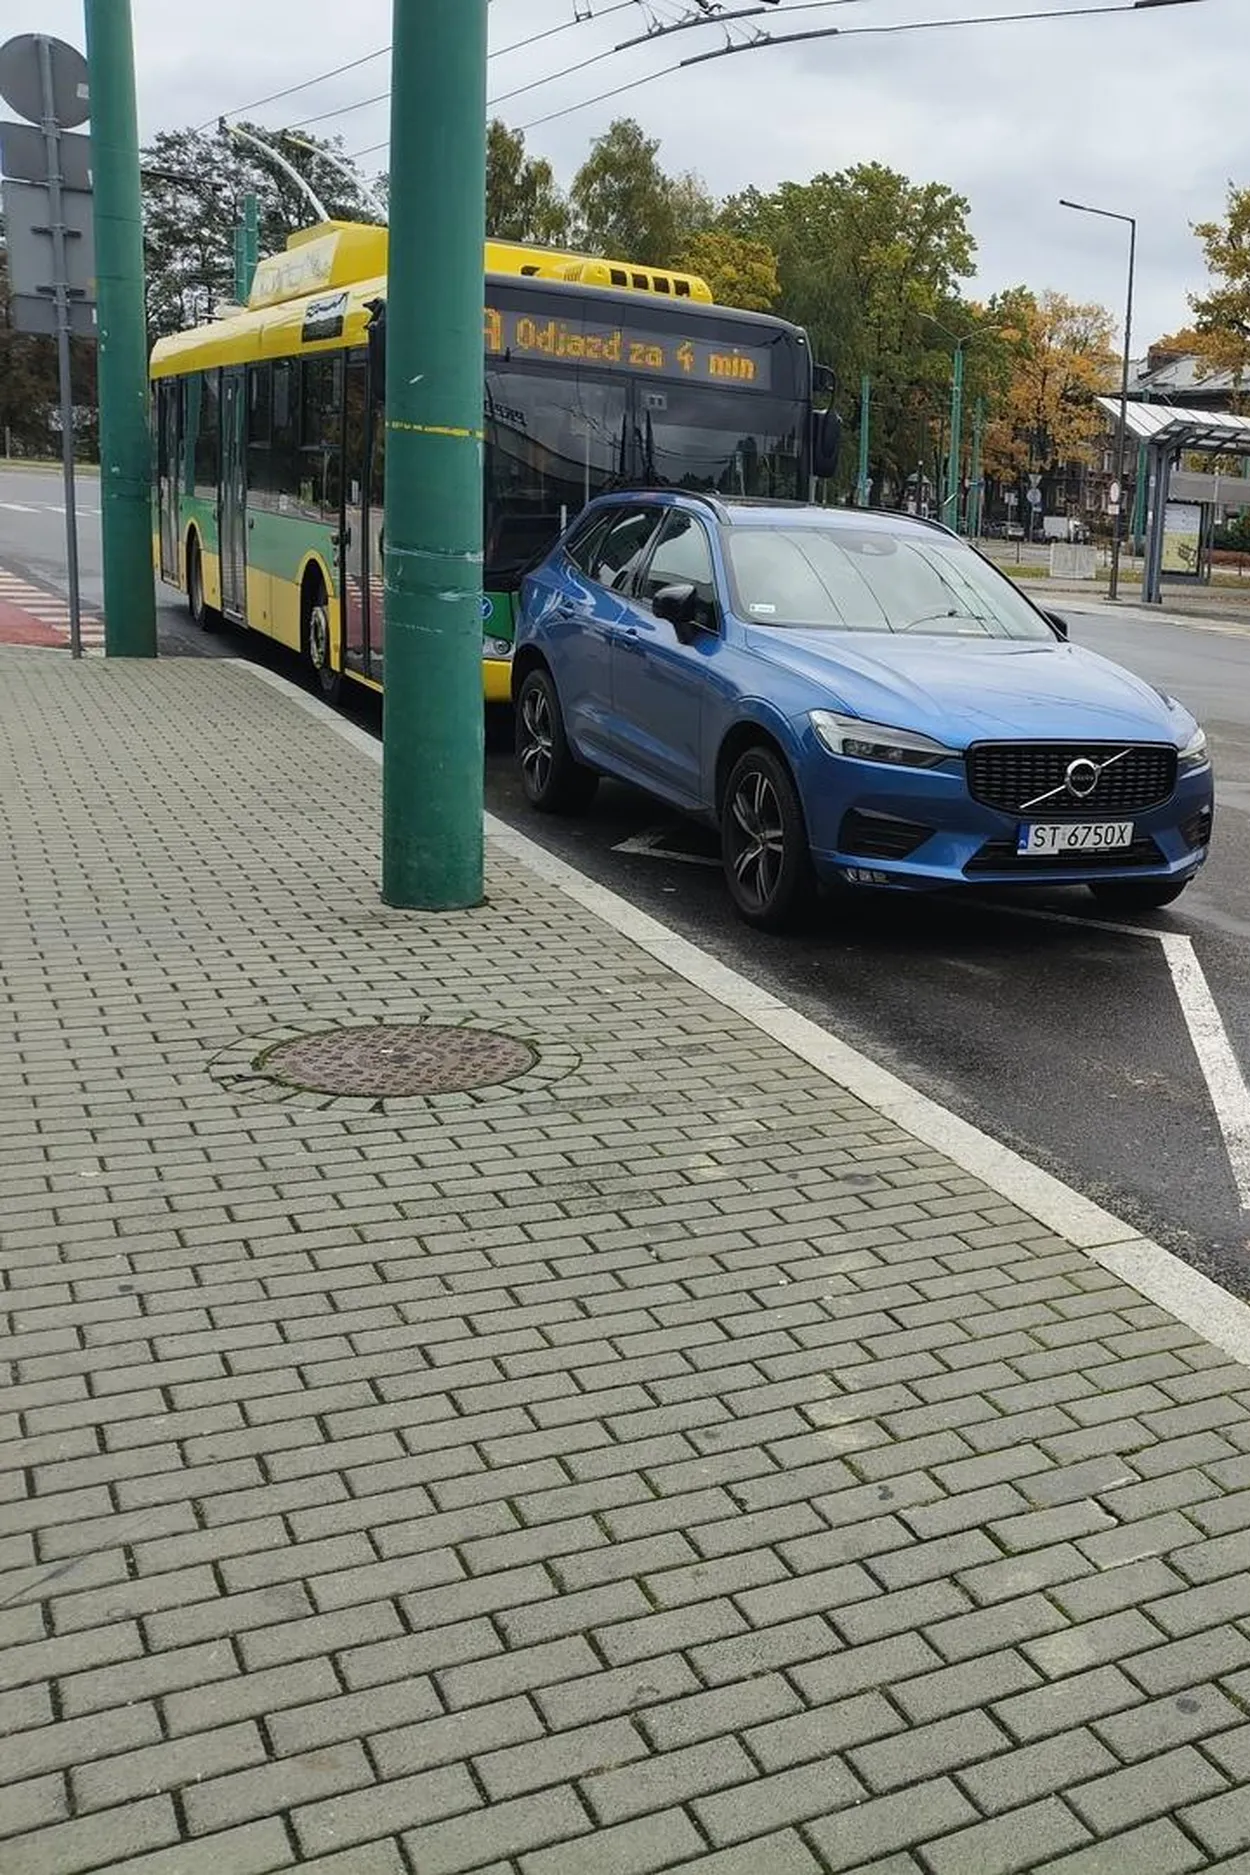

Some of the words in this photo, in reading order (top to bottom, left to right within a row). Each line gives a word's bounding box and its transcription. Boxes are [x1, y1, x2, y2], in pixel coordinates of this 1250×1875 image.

[516, 317, 622, 362] Odjazd
[628, 342, 663, 368] za
[676, 341, 694, 373] 4
[708, 348, 756, 380] min
[1033, 827, 1060, 848] ST
[1067, 825, 1128, 847] 6750X
